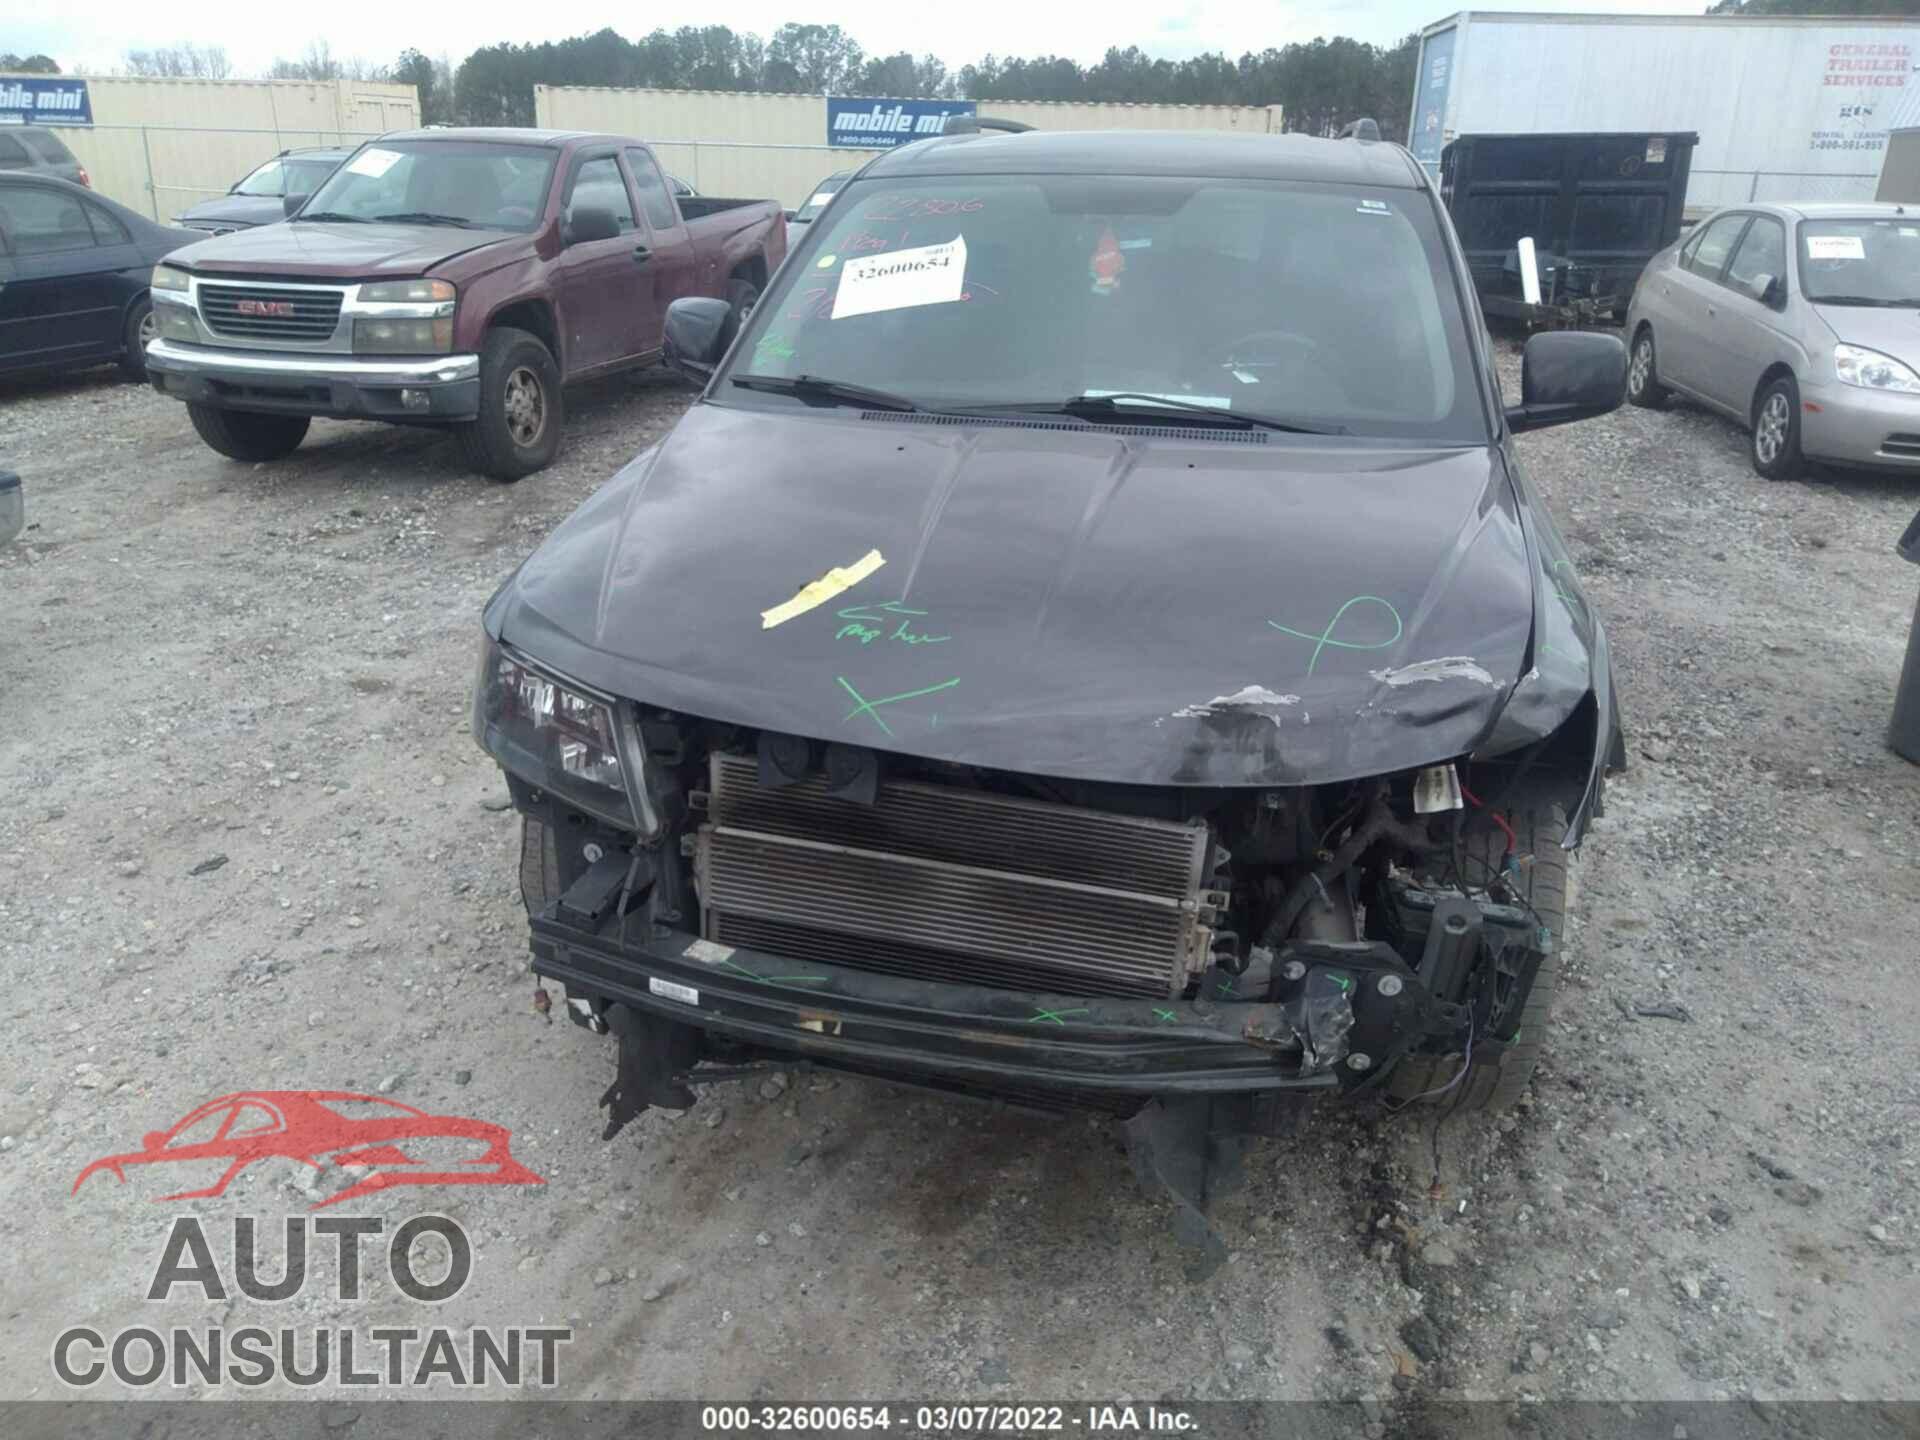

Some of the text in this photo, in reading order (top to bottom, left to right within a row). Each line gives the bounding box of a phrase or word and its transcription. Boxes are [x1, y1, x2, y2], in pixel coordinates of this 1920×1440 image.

[1829, 44, 1911, 57] GENERAL
[1826, 59, 1908, 71] TRAILER
[1823, 74, 1906, 87] SERVICES
[0, 83, 83, 110] bile mini
[833, 104, 914, 133] mobile
[851, 255, 952, 283] 32600654
[238, 300, 294, 316] GMC
